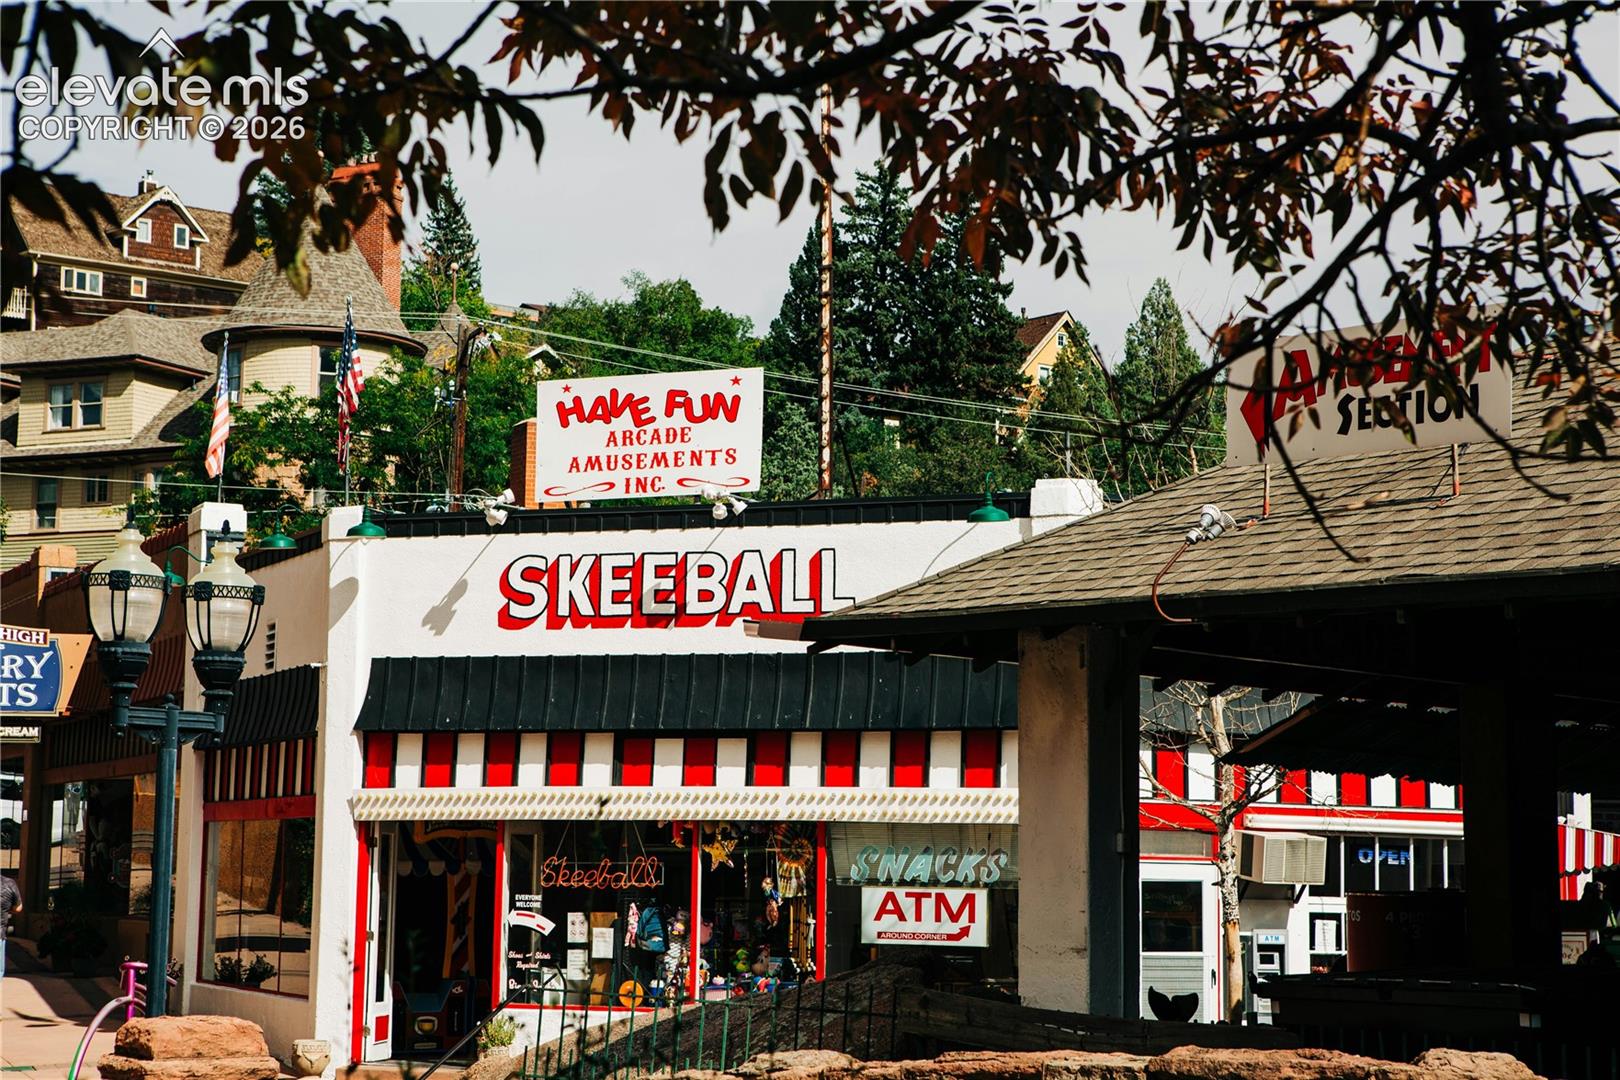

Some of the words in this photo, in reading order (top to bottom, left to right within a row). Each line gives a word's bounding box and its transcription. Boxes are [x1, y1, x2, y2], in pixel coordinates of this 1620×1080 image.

[556, 388, 657, 428] HAVE
[664, 389, 741, 423] FUN
[1336, 383, 1479, 436] SECTION
[605, 427, 692, 447] ARCADE
[567, 448, 737, 473] AMUSEMENTS
[624, 476, 665, 494] INC.
[498, 548, 856, 630] SKEEBALL
[0, 628, 45, 644] HIGH
[0, 727, 39, 737] CREAM
[851, 845, 1009, 884] SNACKS
[1359, 850, 1412, 865] OPEN
[541, 856, 661, 889] Skeeball
[873, 891, 976, 924] ATM
[914, 933, 947, 941] CORNER
